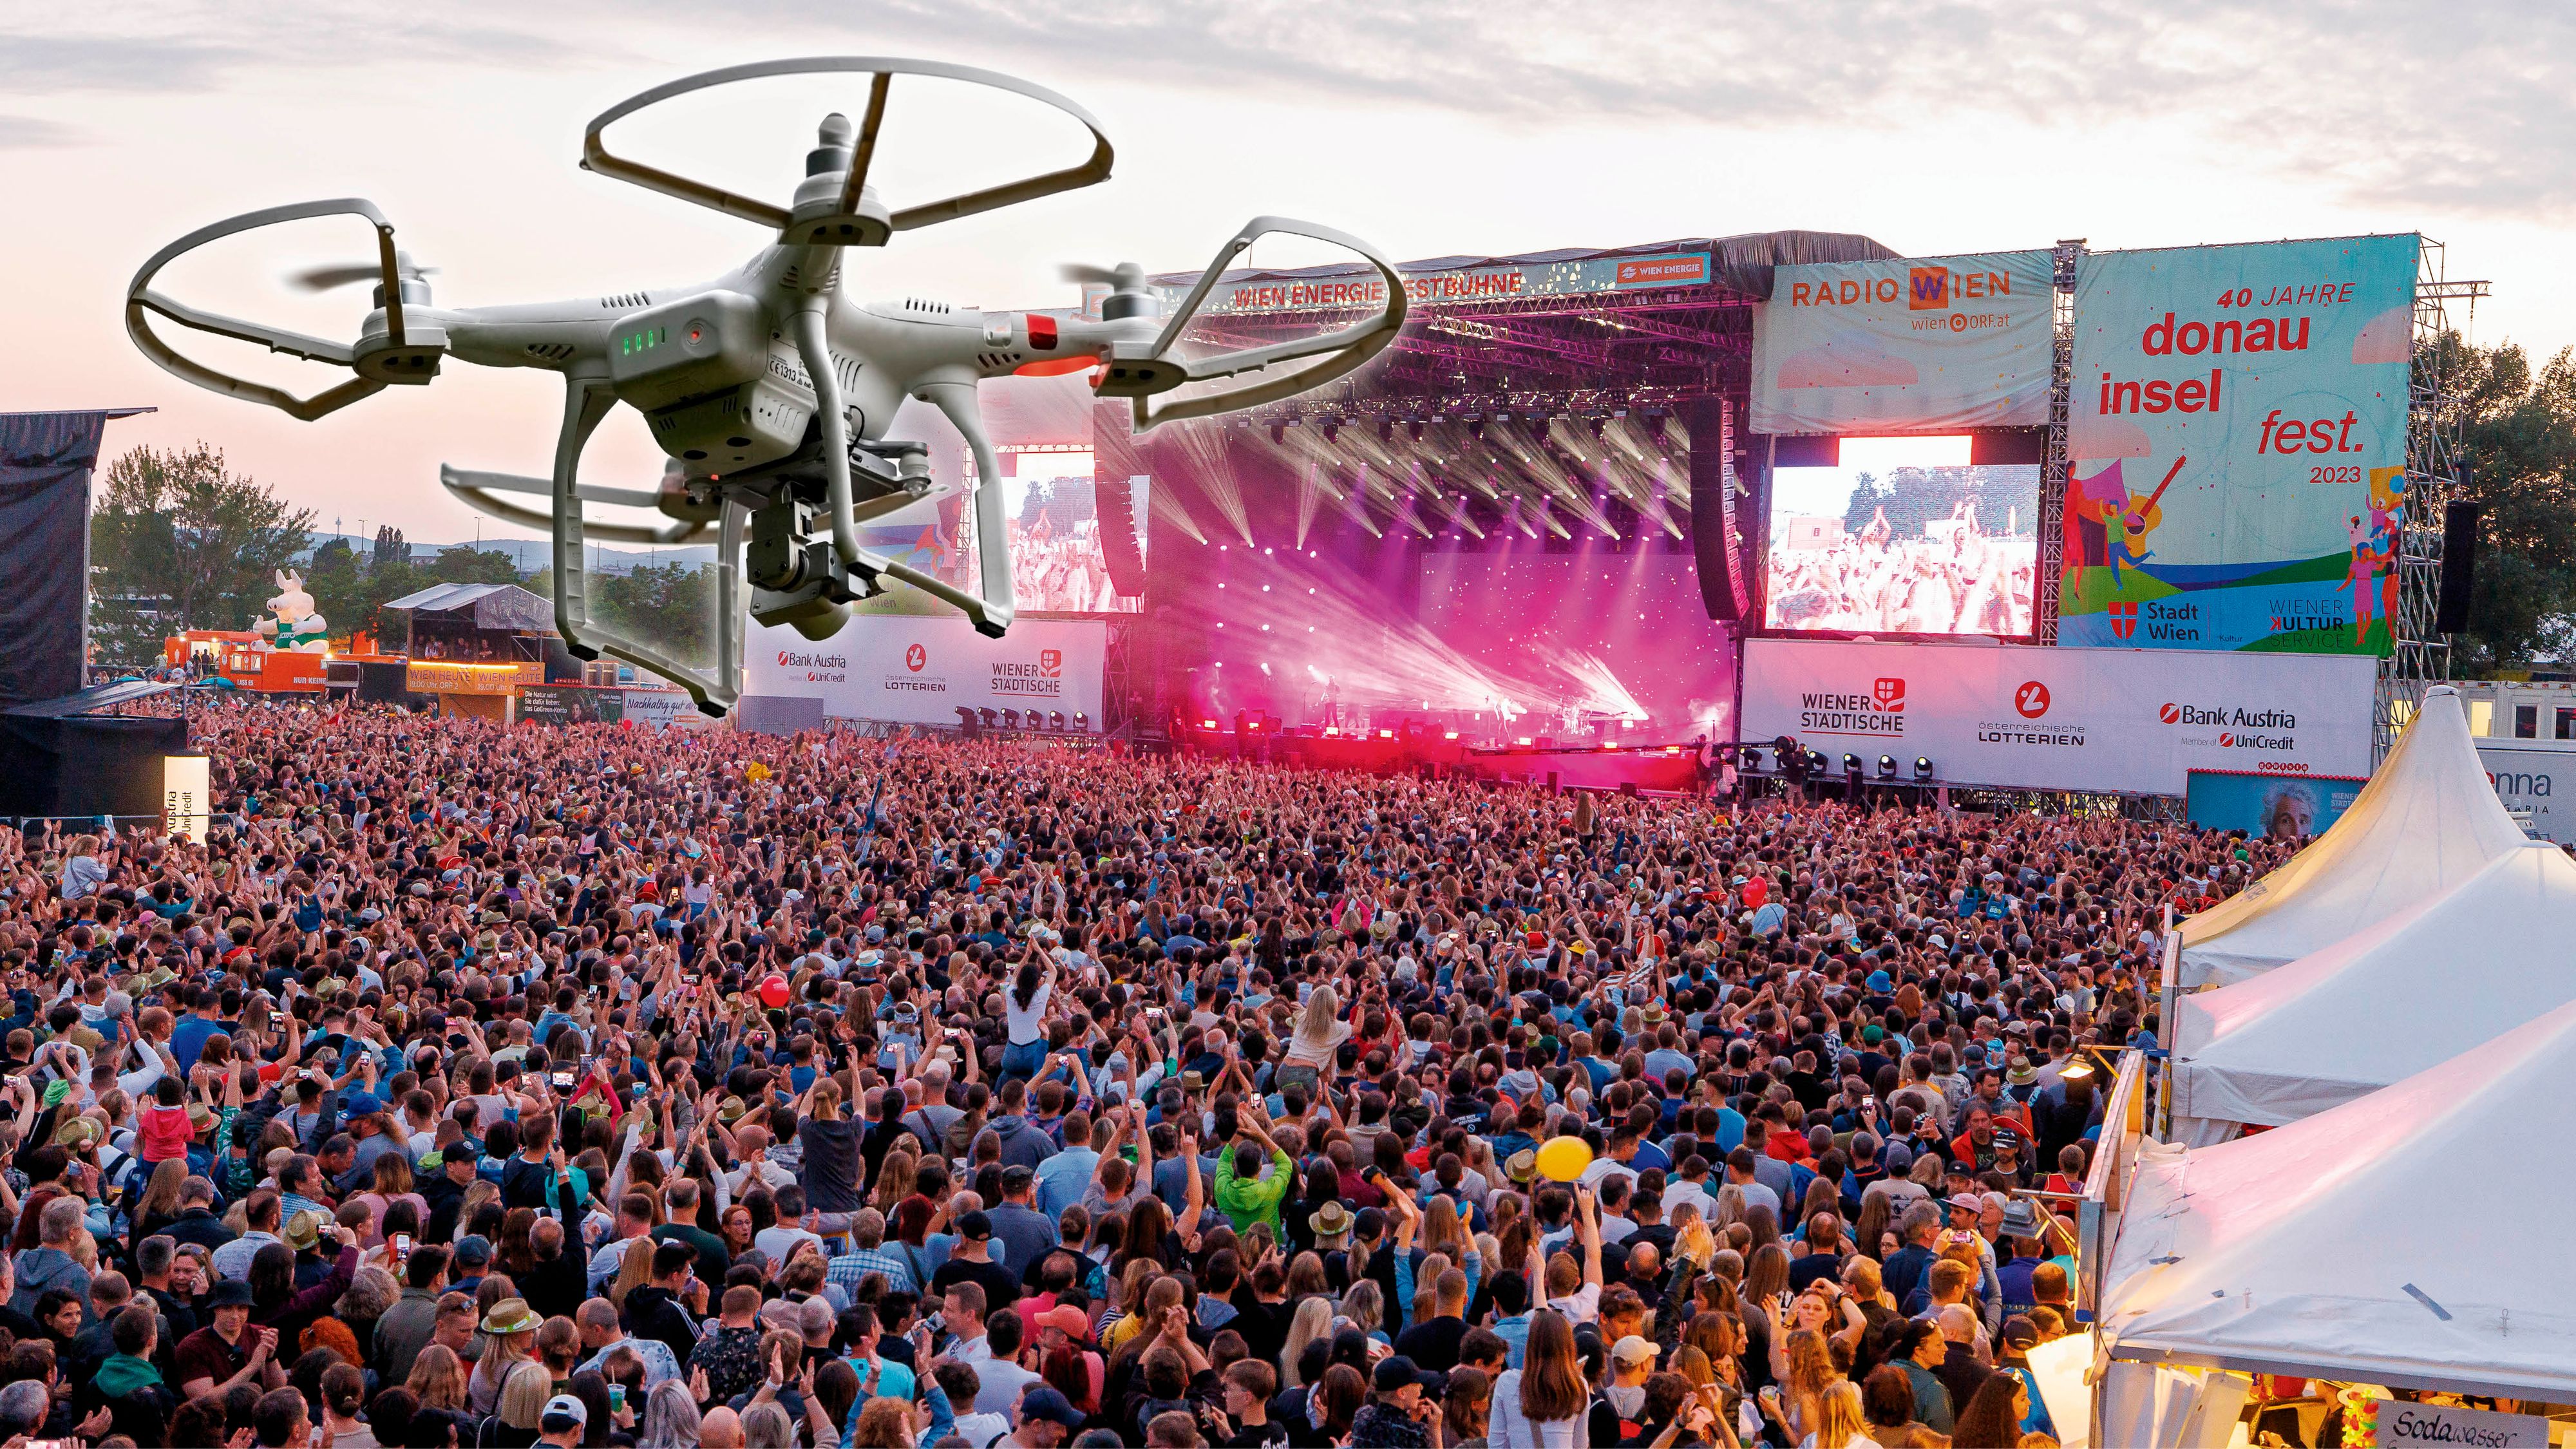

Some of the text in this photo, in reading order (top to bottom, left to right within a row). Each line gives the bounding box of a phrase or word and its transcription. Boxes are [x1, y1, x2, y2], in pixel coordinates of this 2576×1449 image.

[1640, 264, 1700, 275] WIEN ENERGIE
[1235, 271, 1523, 308] WIEN ENERGIE ESTBÜHNE
[1792, 270, 2011, 307] RADIO WIEN
[2217, 283, 2356, 309] 40 JAHRE
[1911, 313, 2010, 331] wien ORF.at
[2142, 312, 2311, 356] donau
[2099, 368, 2222, 415] insel
[2258, 409, 2364, 454] fest.
[2309, 466, 2361, 484] 2023
[2147, 601, 2199, 621] Stadt
[2269, 598, 2343, 615] WIENER
[2147, 623, 2199, 641] Wien
[2269, 616, 2344, 632] KULTUR
[2219, 634, 2243, 643] Kultur
[2271, 632, 2345, 649] SERVICE
[789, 652, 846, 668] Bank Austria
[410, 669, 470, 681] WIEN HEUTE
[478, 672, 541, 683] WIEN HEUTE
[816, 672, 846, 683] UniCredit
[992, 662, 1038, 677] WIENER
[885, 674, 946, 683] österreichische
[885, 682, 946, 692] LOTTERIEN
[991, 677, 1061, 693] STÄDTISCHE
[627, 697, 670, 714] Nachhaltig
[670, 699, 685, 714] gut
[1802, 693, 1871, 712] WIENER
[1801, 712, 1904, 732] STÄDTISCHE
[2183, 705, 2295, 730] Bank Austria
[1978, 721, 2085, 733] österreichische
[1978, 732, 2085, 746] LOTTERIEN
[2181, 734, 2295, 750] Member of UniCredit
[182, 791, 192, 832] UniCredit
[2392, 1411, 2517, 1448] Sodawasser
